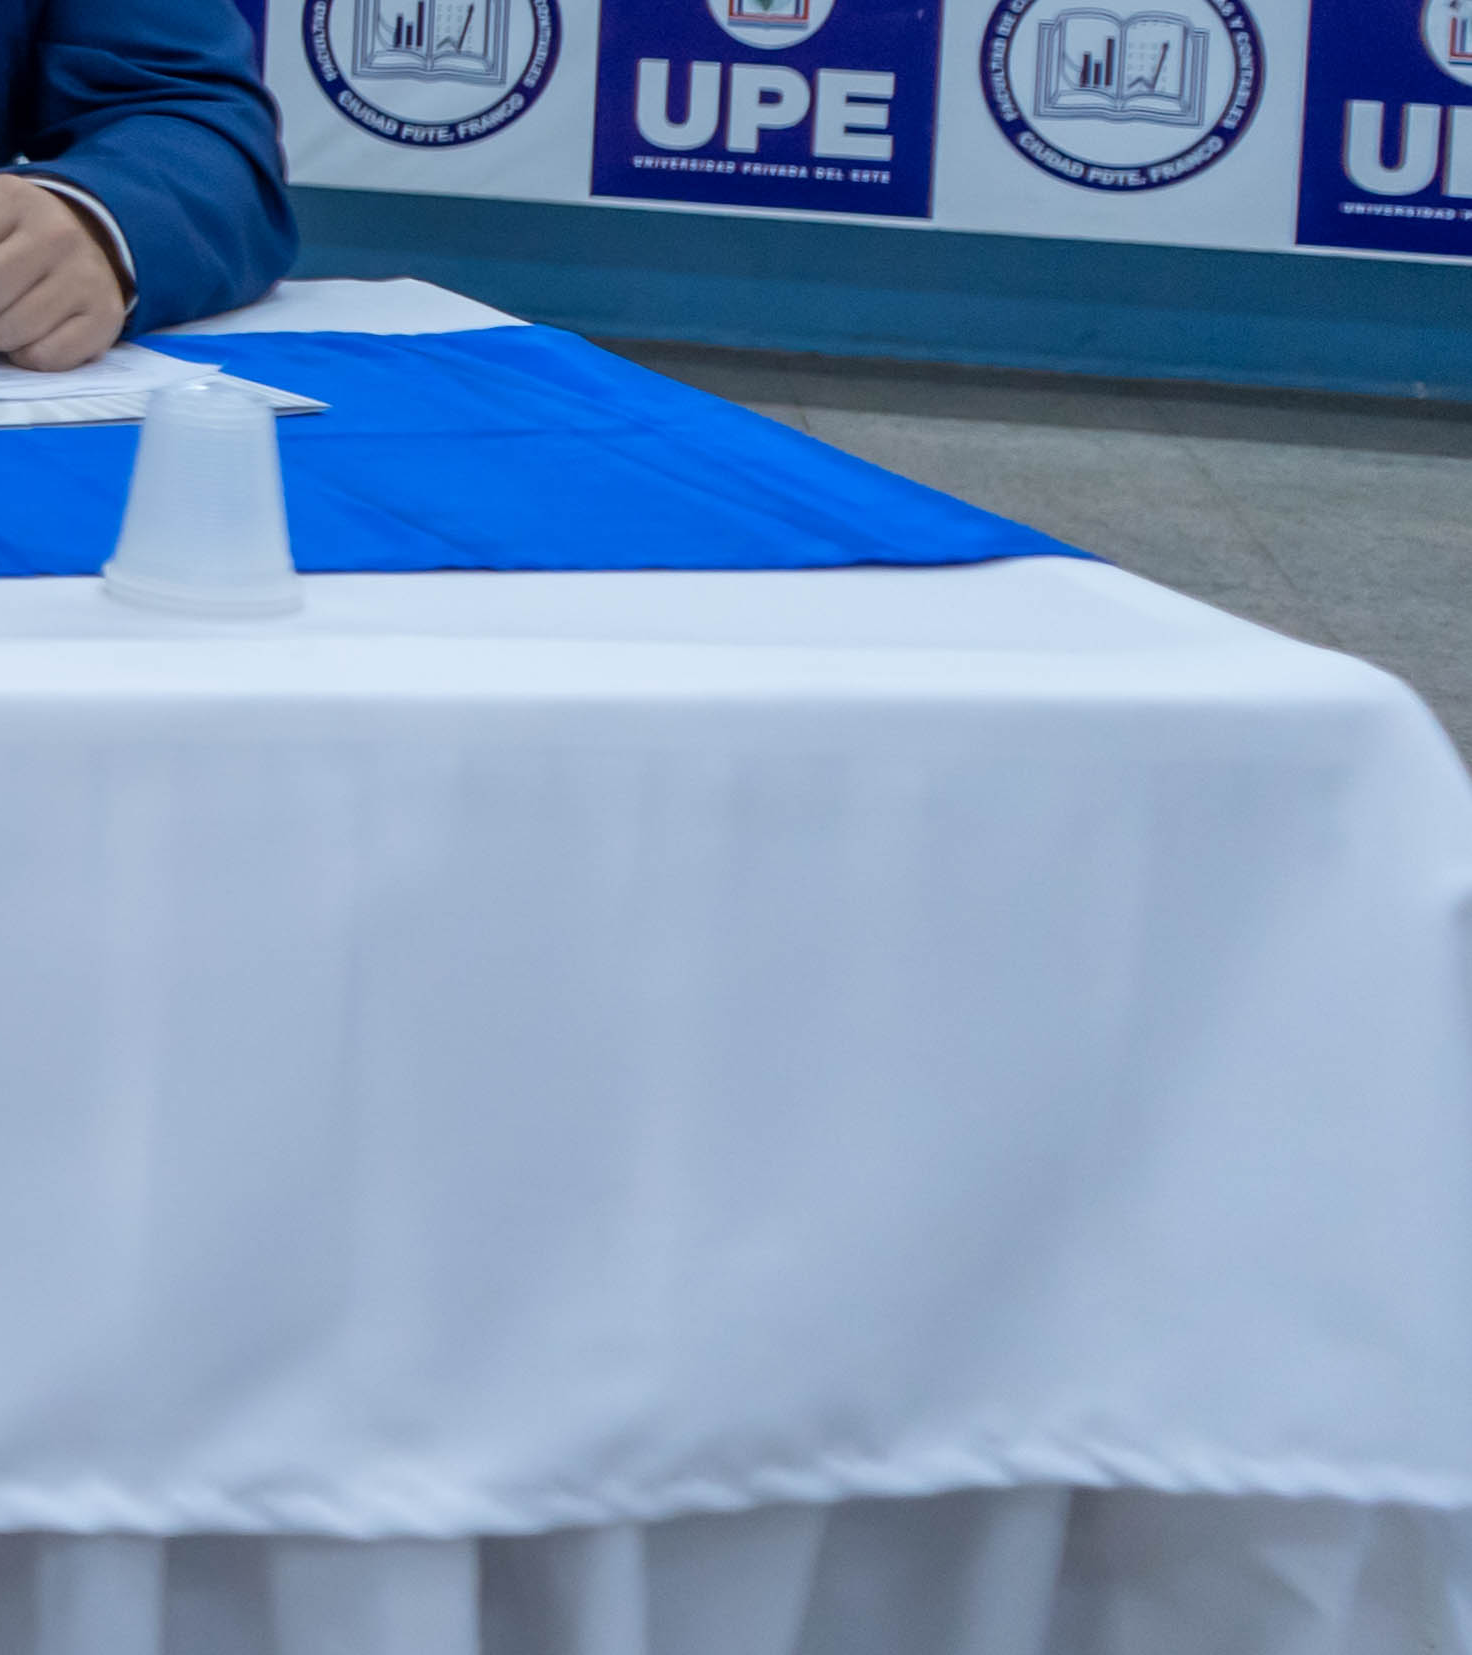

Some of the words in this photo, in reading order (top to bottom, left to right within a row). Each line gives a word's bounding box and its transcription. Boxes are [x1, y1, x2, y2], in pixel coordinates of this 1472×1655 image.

[997, 12, 1016, 35] DE
[337, 88, 399, 134] CIUDAD
[458, 91, 524, 136] FRANCO
[636, 57, 894, 160] UPE
[633, 156, 735, 173] UNIVERSIDAD
[743, 162, 809, 178] PRIVADA
[815, 167, 843, 180] DEL
[850, 169, 890, 183] ESTE
[1017, 129, 1084, 177] CIUDAD
[1149, 133, 1223, 180] FRANCO
[1342, 202, 1456, 221] UNIVERSIDAD
